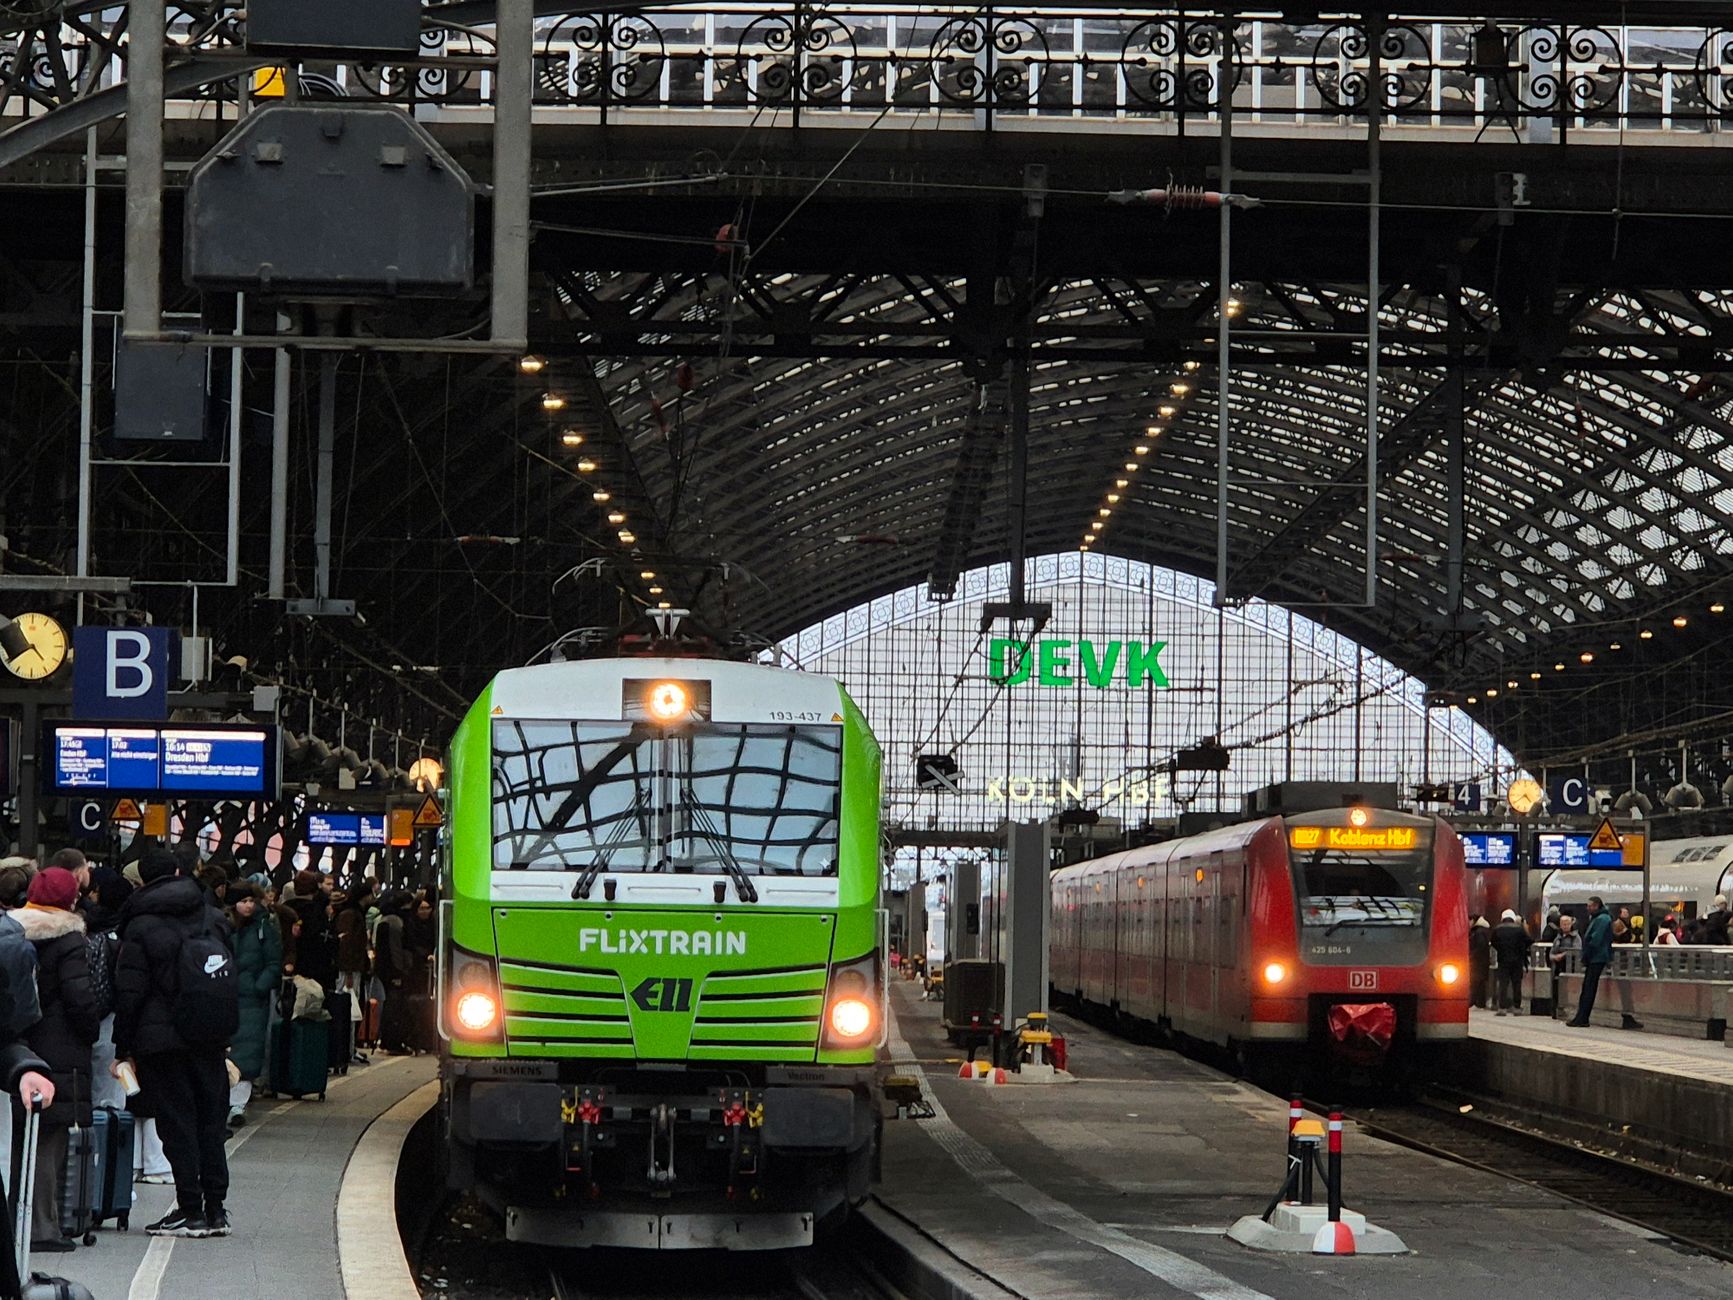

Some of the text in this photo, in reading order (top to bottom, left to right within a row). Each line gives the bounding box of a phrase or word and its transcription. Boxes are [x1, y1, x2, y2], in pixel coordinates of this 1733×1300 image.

[106, 630, 152, 697] B
[989, 638, 1170, 688] DEVK
[769, 711, 821, 722] 193-437
[165, 752, 210, 764] Dresden Hbf
[987, 775, 1171, 805] KÖLN HBF
[1457, 784, 1471, 806] 4
[1562, 778, 1583, 807] C
[81, 802, 101, 831] C
[1329, 827, 1386, 846] Koblenz
[1387, 827, 1412, 846] Hbf
[1351, 972, 1375, 988] DB
[492, 1064, 543, 1076] SIEMENS
